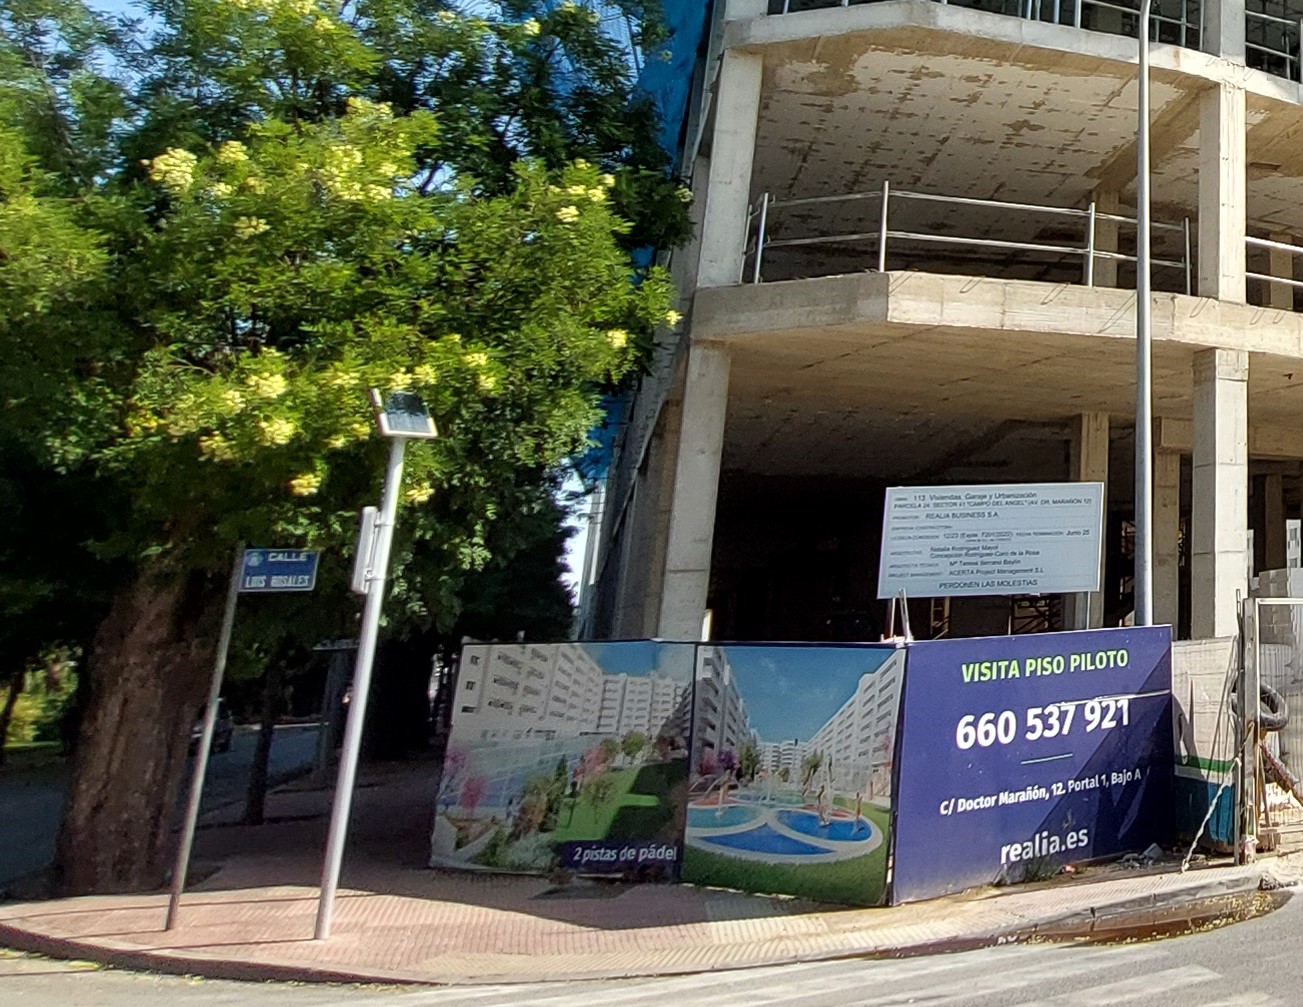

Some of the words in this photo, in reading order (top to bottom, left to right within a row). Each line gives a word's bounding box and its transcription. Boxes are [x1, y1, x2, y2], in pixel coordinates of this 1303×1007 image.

[268, 553, 307, 561] CALLE
[245, 576, 266, 587] LUIS
[271, 575, 309, 587] ROSALES
[939, 581, 980, 589] PERDONEN
[997, 579, 1038, 587] MOLESTIAS
[962, 660, 1020, 683] VISITA
[1025, 655, 1065, 677] PISO
[1070, 649, 1128, 672] PILOTO
[956, 710, 1017, 750] 660
[1025, 703, 1076, 741] 537
[1084, 698, 1130, 732] 921
[940, 801, 954, 815] C/
[957, 794, 997, 813] Doctor
[1000, 785, 1050, 806] Marañón,
[1068, 774, 1100, 792] Portal
[1111, 770, 1133, 786] Bajo
[1134, 768, 1142, 780] A
[573, 847, 582, 861] 2
[582, 844, 617, 864] pistas
[620, 846, 636, 861] de
[637, 844, 677, 862] pádel
[1001, 828, 1089, 864] realia.es
